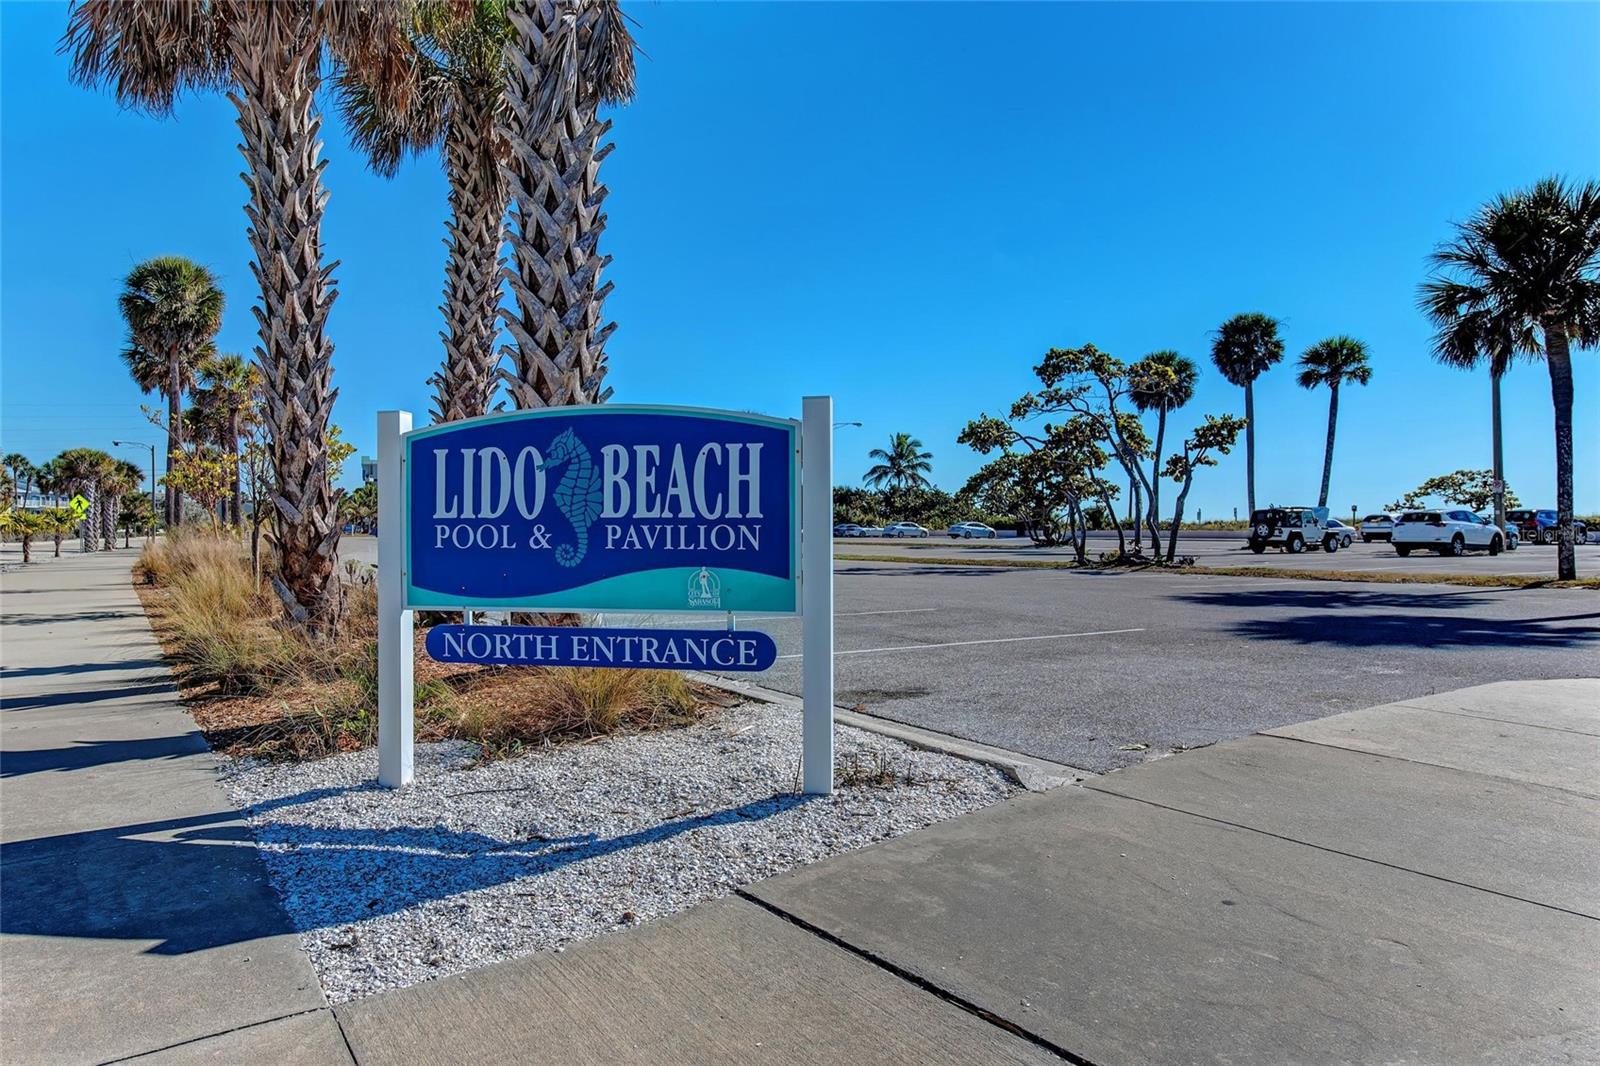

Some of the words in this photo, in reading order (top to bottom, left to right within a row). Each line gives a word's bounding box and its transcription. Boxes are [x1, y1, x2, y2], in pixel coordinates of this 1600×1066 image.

[433, 446, 546, 519] LIDO
[600, 443, 764, 519] BEACH
[435, 525, 516, 549] POOL
[529, 524, 552, 549] &
[605, 525, 760, 550] PAVILION
[443, 633, 559, 660] NORTH
[570, 636, 758, 666] ENTRANCE
